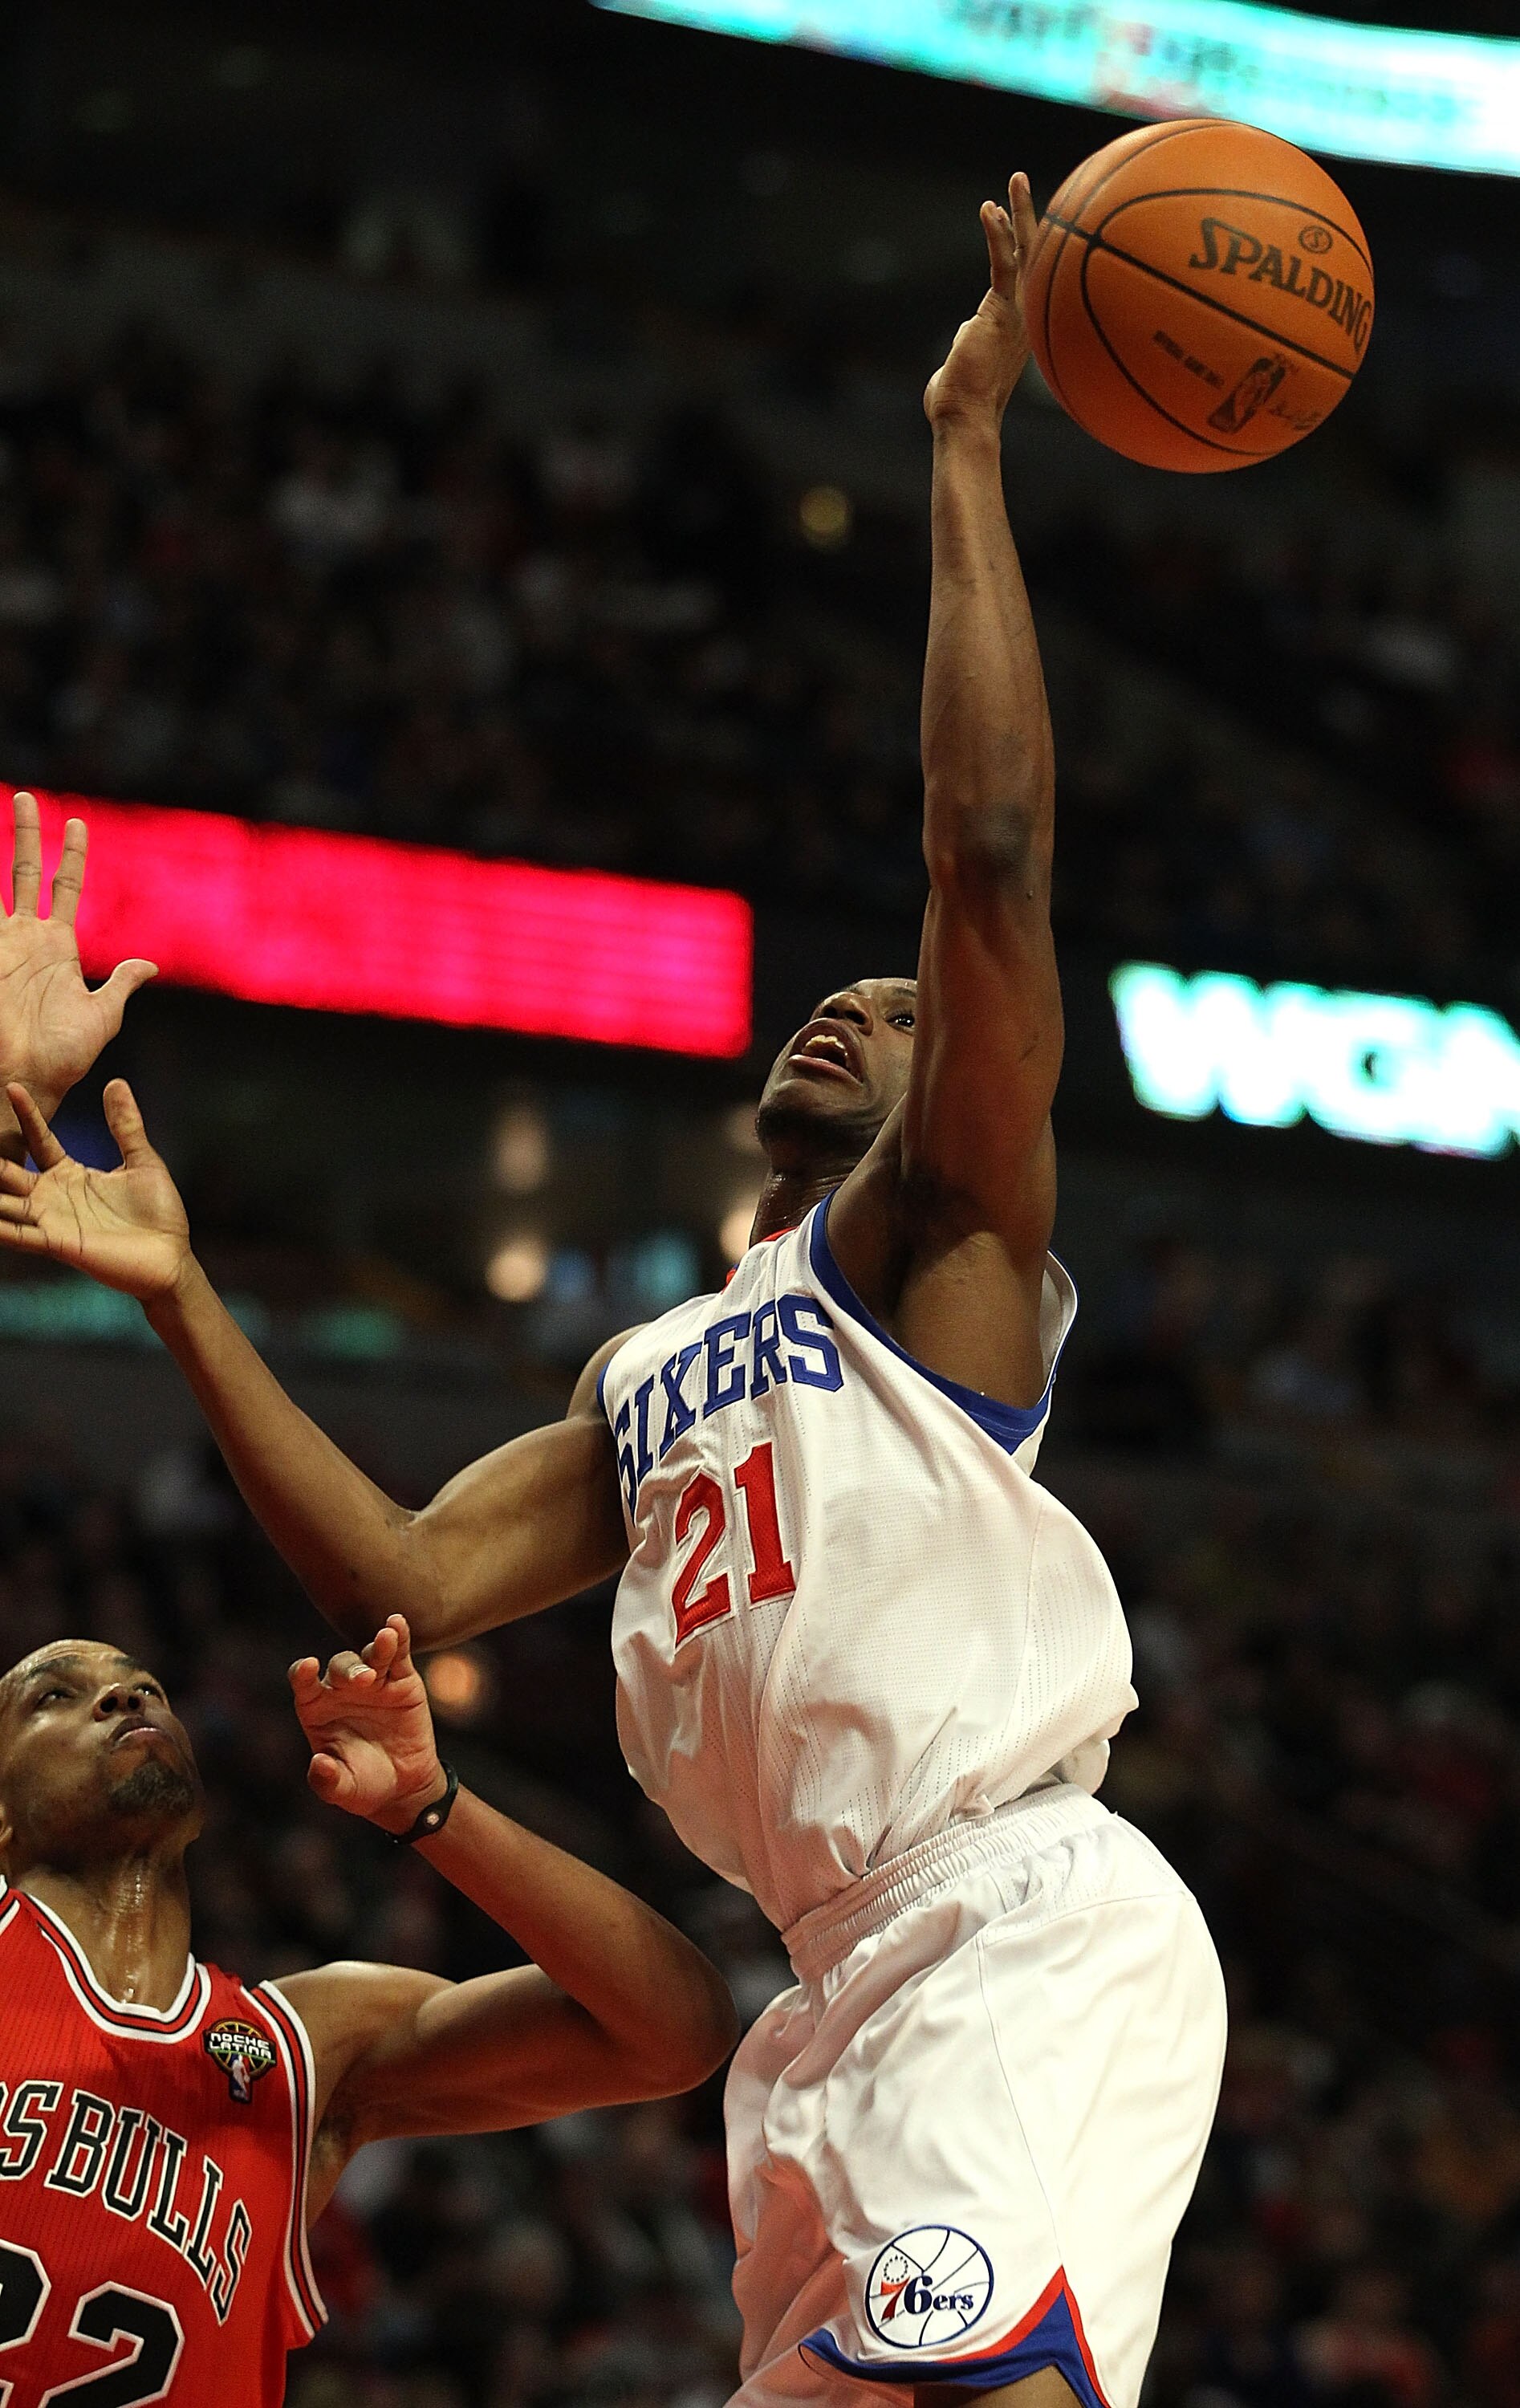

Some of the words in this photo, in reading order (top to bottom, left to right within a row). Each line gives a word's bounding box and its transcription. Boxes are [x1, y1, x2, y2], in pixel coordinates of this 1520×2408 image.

[1189, 217, 1372, 354] SPALDING
[615, 1293, 844, 1528] SIXERS
[671, 1442, 797, 1649] 21
[209, 2041, 272, 2060] LATINA
[210, 2032, 270, 2050] NOCHE
[44, 2089, 252, 2326] BULLS
[880, 2275, 974, 2322] 76ers
